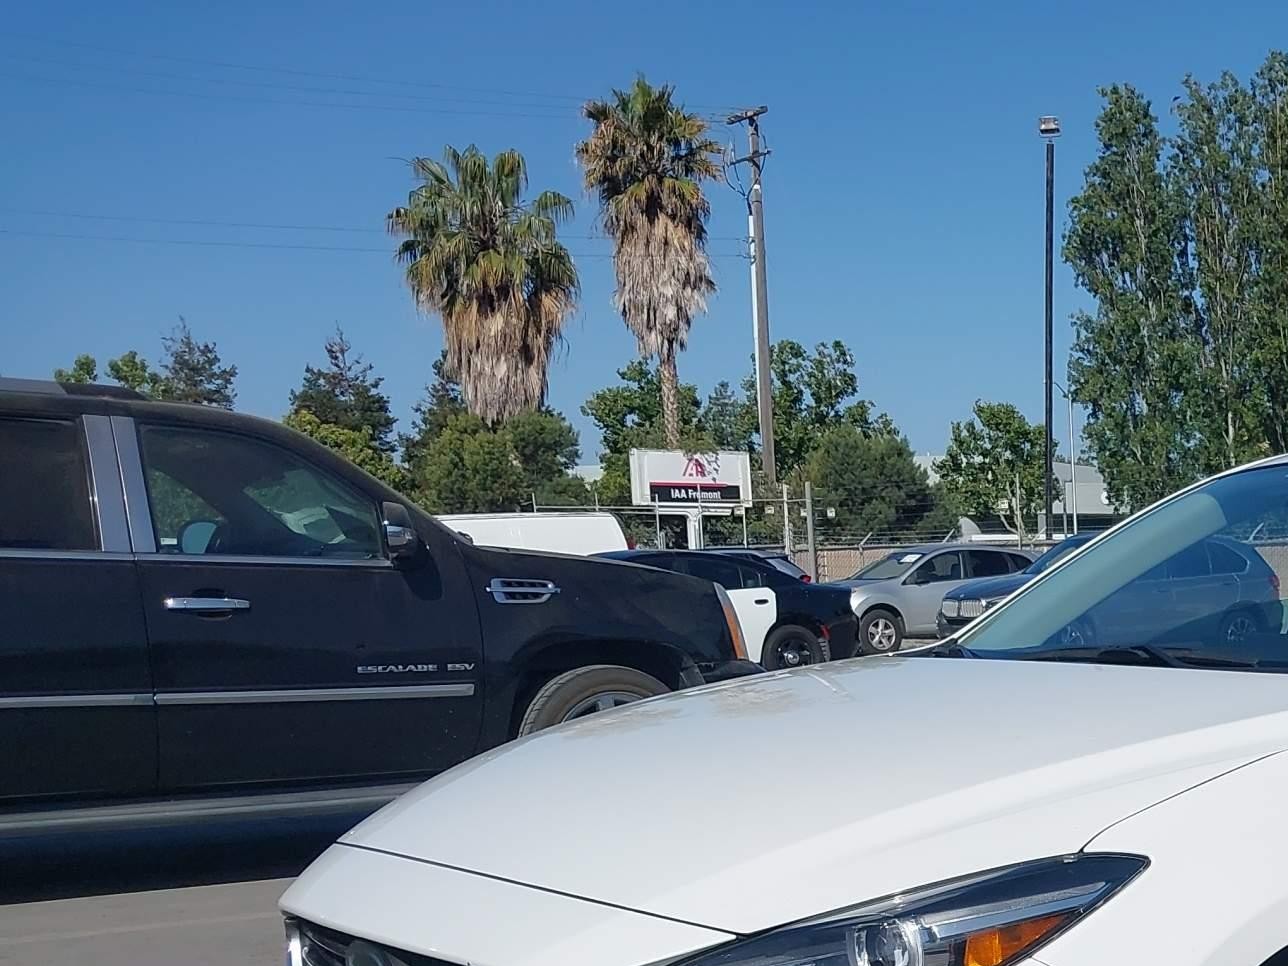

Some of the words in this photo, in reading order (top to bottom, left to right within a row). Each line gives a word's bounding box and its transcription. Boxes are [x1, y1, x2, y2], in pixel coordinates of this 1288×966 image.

[670, 488, 687, 499] IAA
[356, 663, 438, 674] ESCALADE
[446, 663, 475, 671] ESV
